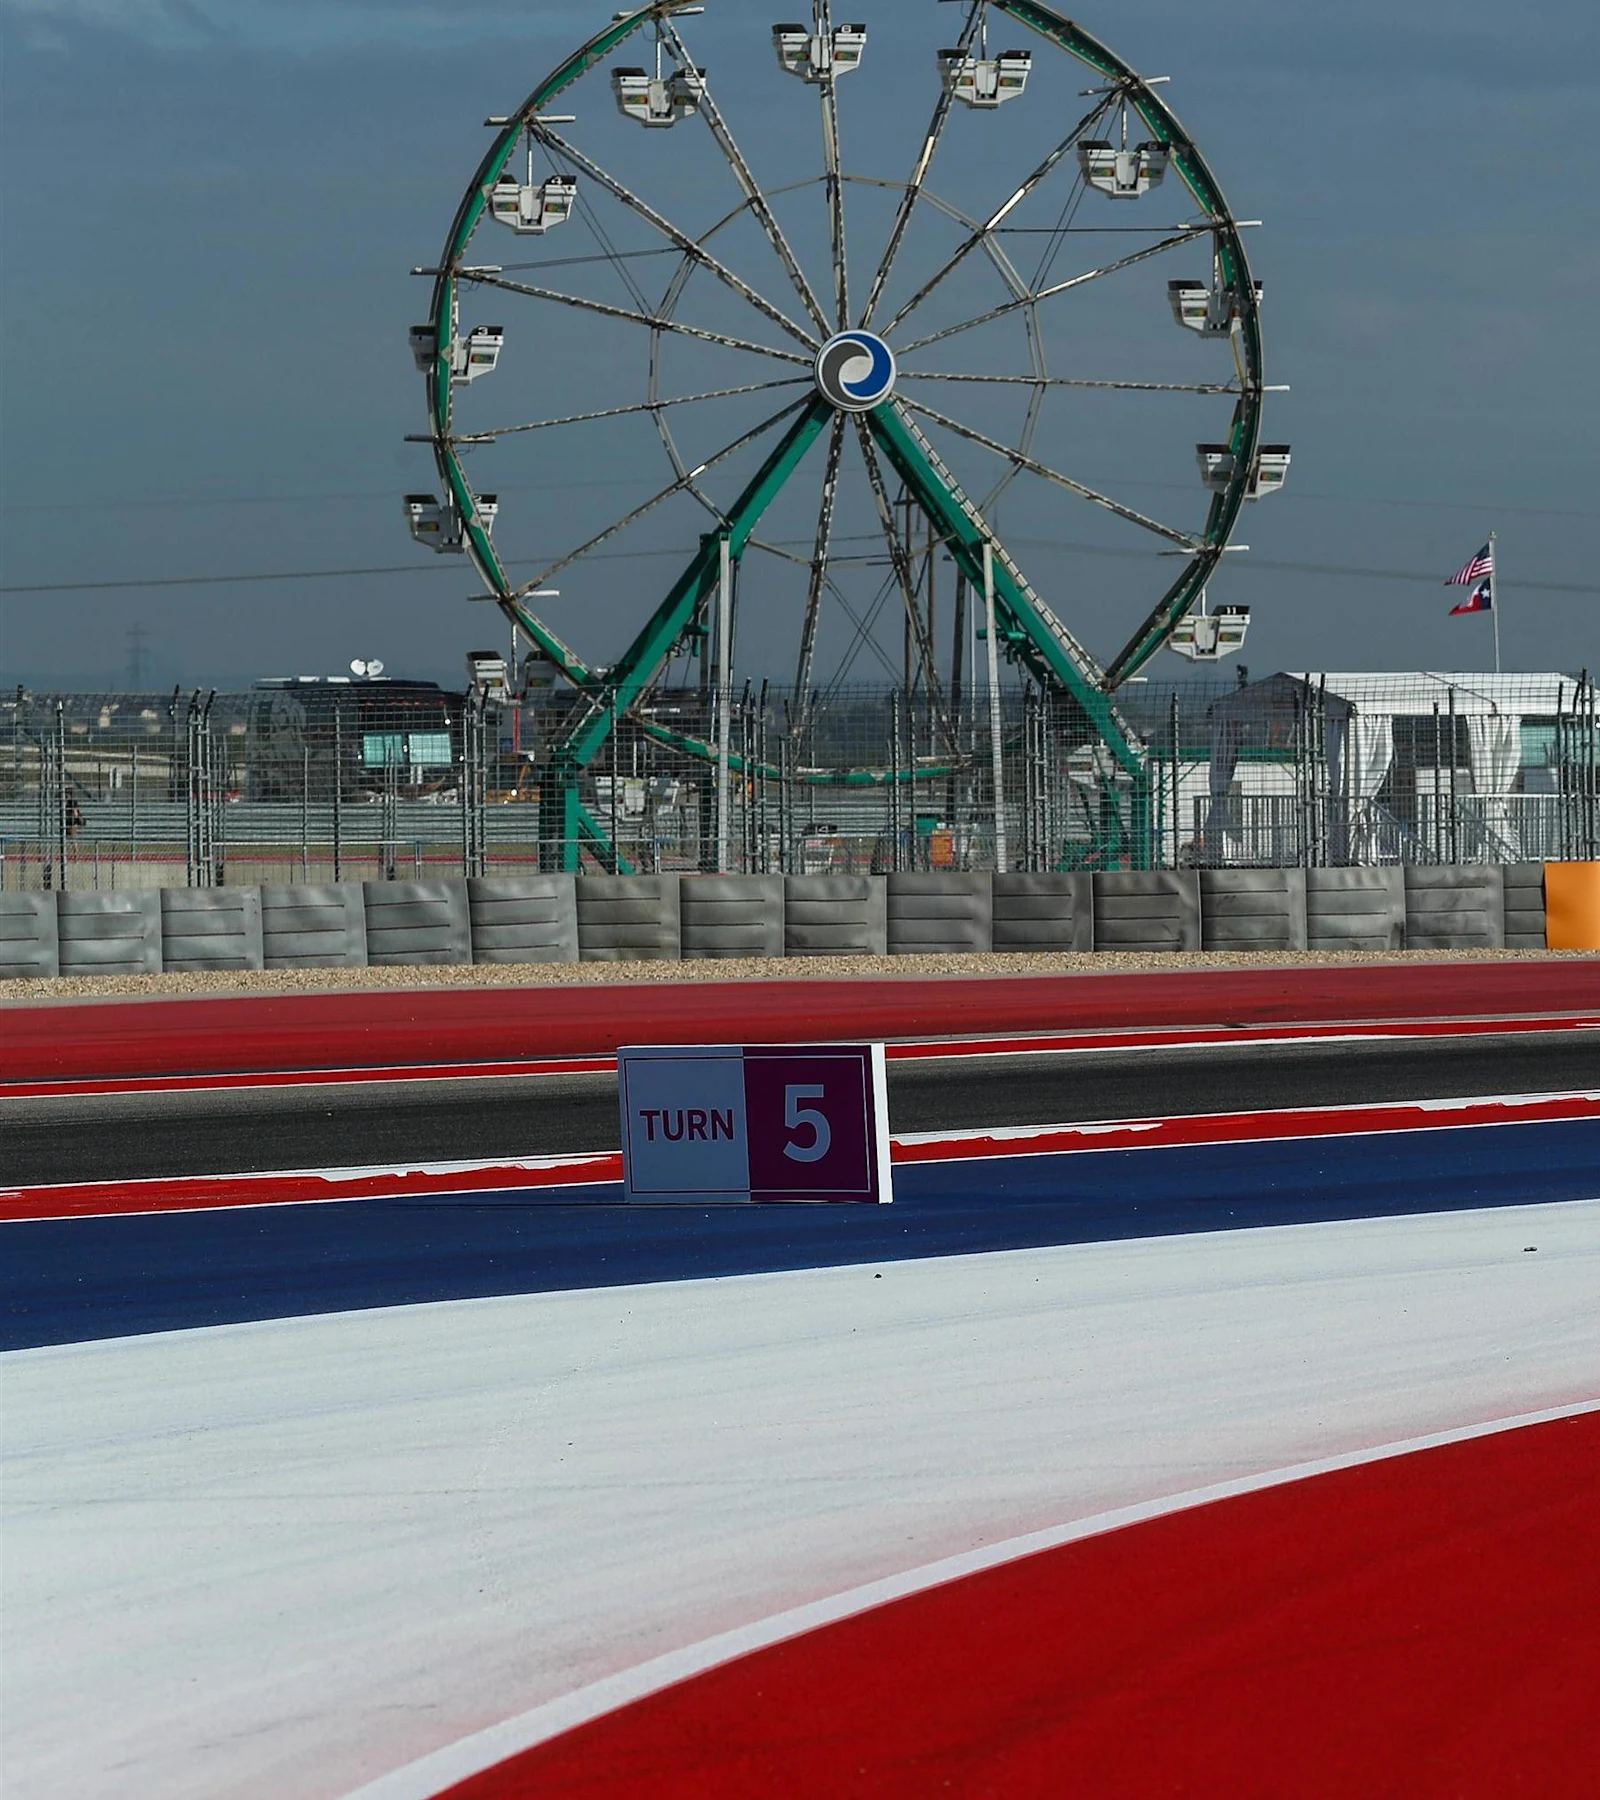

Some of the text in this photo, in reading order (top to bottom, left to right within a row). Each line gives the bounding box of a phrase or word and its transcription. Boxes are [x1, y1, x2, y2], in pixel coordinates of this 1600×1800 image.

[551, 176, 562, 185] 4
[478, 326, 488, 336] 3
[1225, 606, 1236, 615] 11
[639, 1083, 832, 1163] TURN 5
